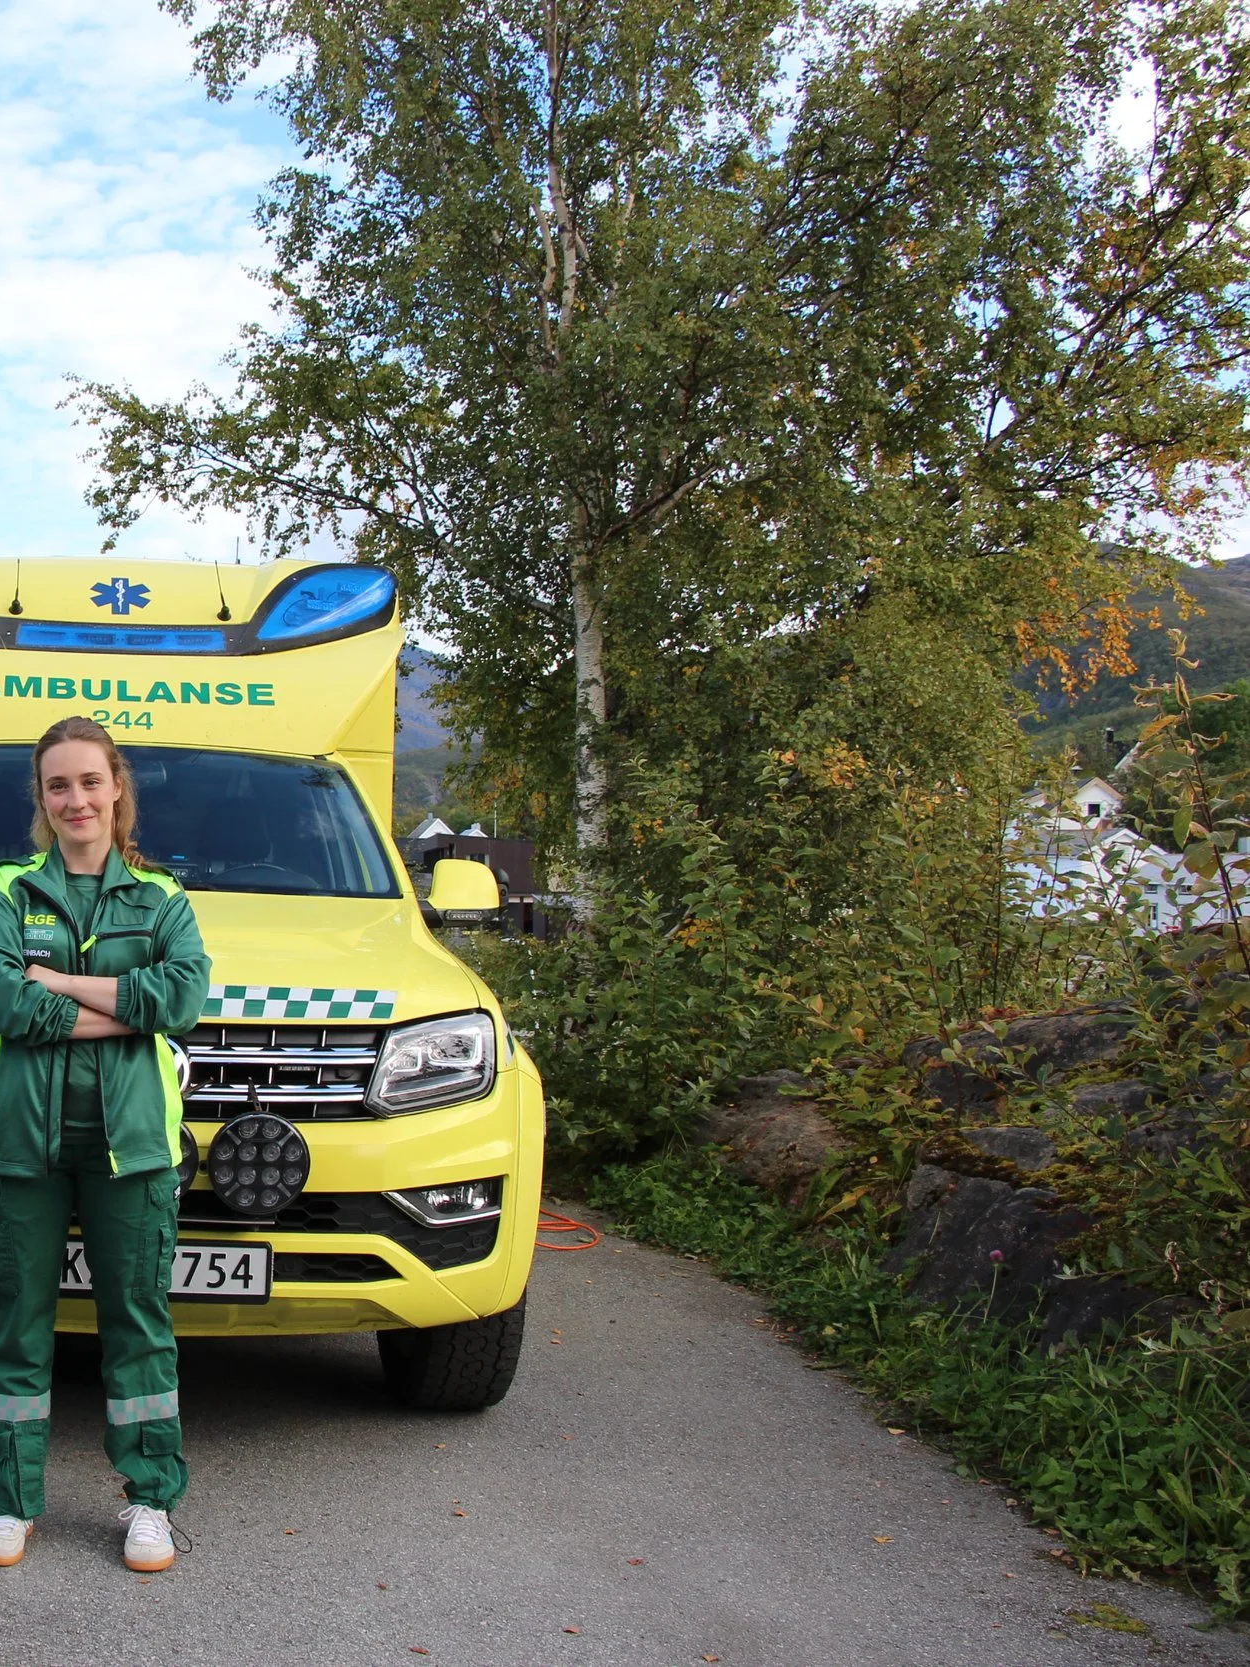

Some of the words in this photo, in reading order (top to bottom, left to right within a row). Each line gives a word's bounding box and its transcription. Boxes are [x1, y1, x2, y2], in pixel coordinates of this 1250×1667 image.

[93, 709, 154, 730] 244
[61, 1248, 92, 1284] K
[170, 1251, 254, 1289] 754
